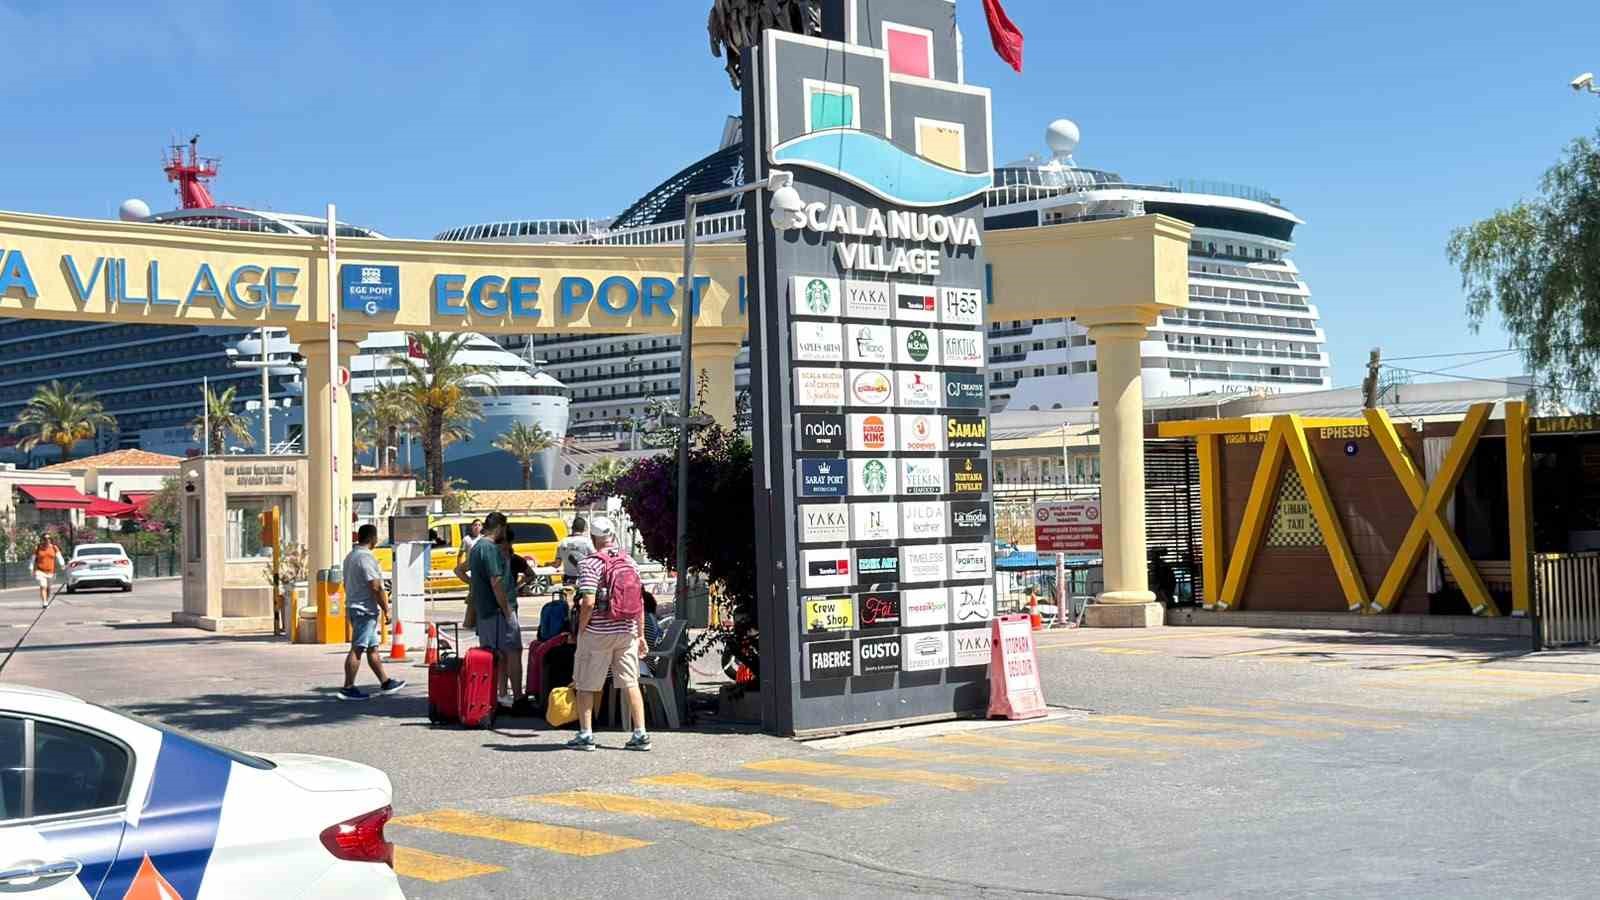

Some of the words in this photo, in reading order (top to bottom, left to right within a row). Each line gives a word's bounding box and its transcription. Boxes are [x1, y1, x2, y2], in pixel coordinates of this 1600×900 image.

[836, 241, 941, 275] VILLAGE
[60, 254, 301, 311] VILLAGE
[349, 286, 368, 295] EGE
[369, 286, 393, 295] PORT
[434, 273, 543, 318] EGE
[559, 275, 711, 317] PORT
[850, 288, 886, 304] YAKA
[805, 421, 842, 436] nalan
[1319, 426, 1370, 440] EPHESUS
[863, 432, 885, 442] KING
[808, 512, 846, 526] YAKA
[813, 603, 836, 614] Crew
[827, 615, 849, 627] Shop
[861, 642, 900, 660] GUSTO
[958, 637, 991, 651] YAKA
[812, 650, 851, 670] FABERCE
